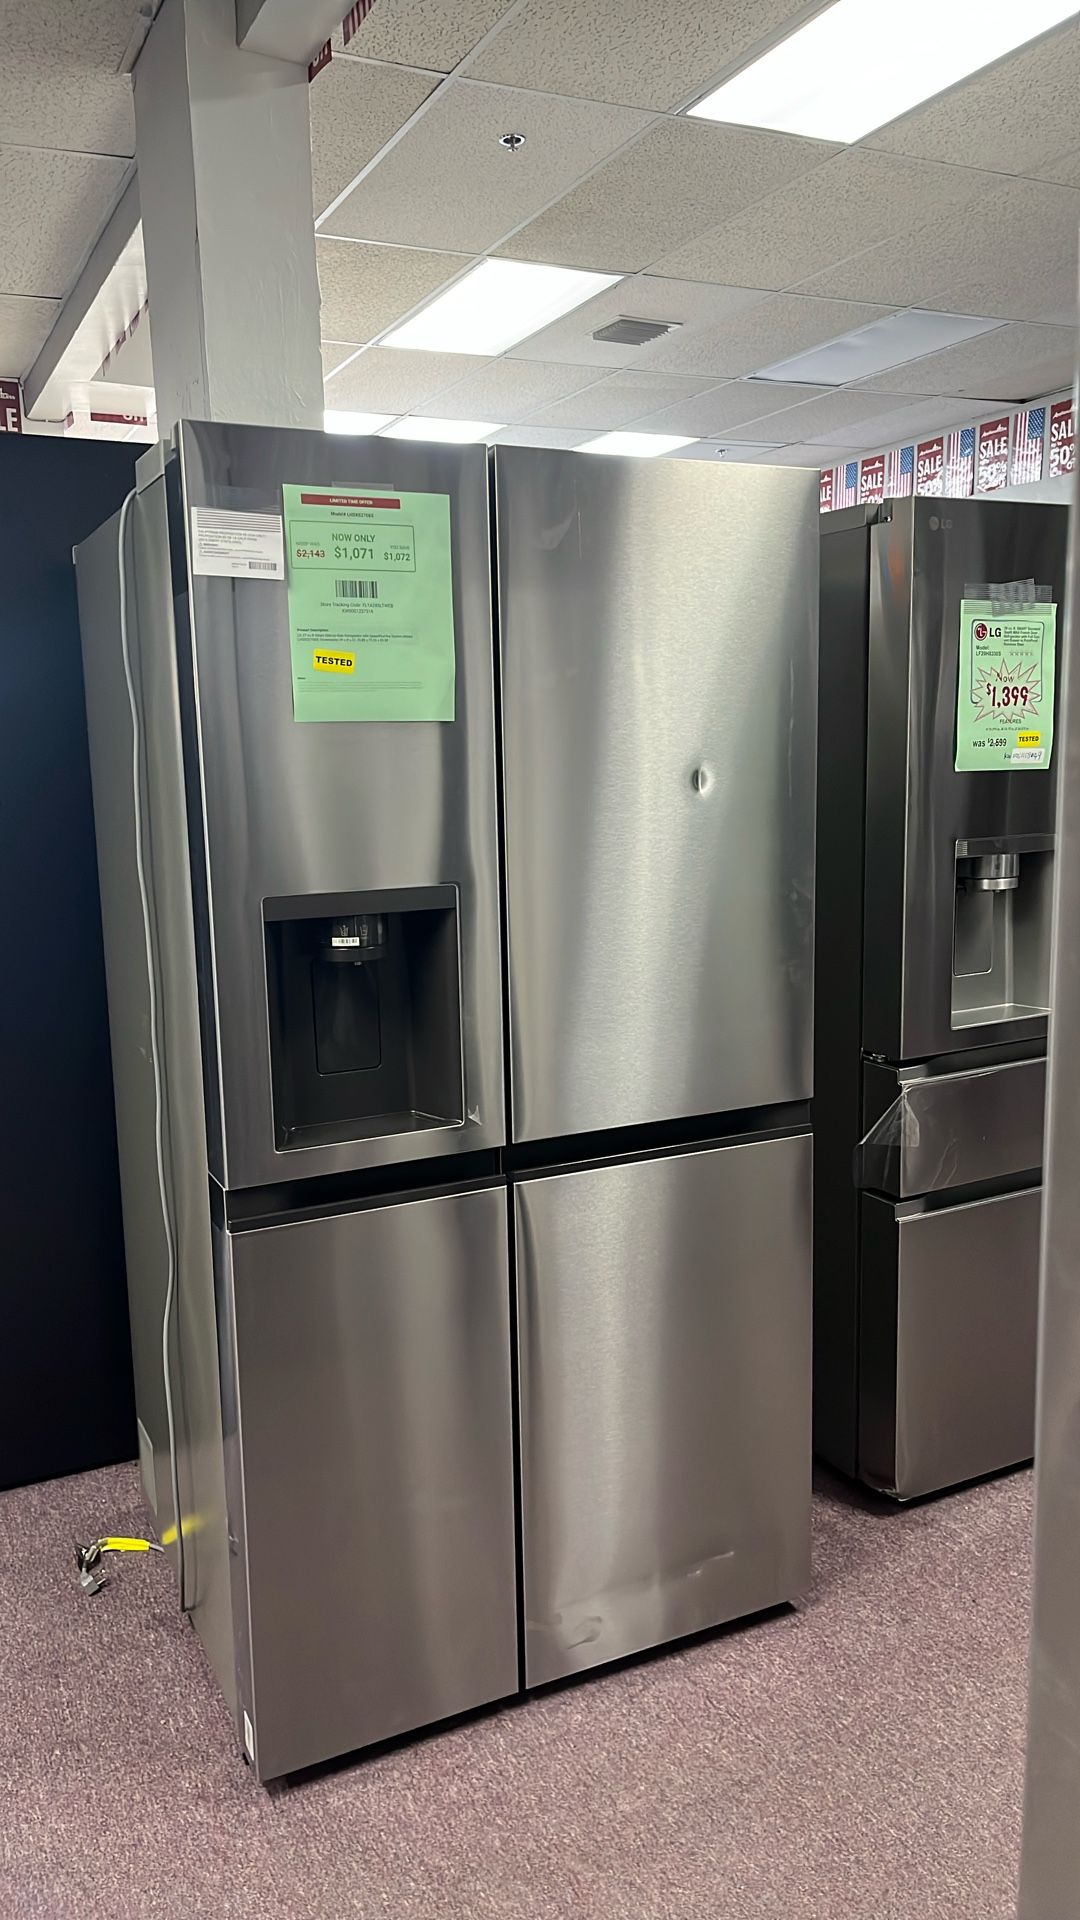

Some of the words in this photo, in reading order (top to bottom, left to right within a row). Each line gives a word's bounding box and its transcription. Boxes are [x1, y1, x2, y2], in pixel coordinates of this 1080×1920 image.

[1051, 419, 1074, 442] SAL
[979, 437, 1008, 459] SALE
[917, 455, 942, 477] SALE
[861, 472, 883, 492] SALE
[332, 533, 352, 542] NOW
[354, 534, 376, 543] ONLY
[296, 549, 326, 559] $2,143
[334, 545, 374, 561] $1,071
[383, 551, 411, 562] $1,072
[315, 655, 353, 667] TESTED
[986, 682, 1029, 708] $1,399
[972, 740, 986, 748] was
